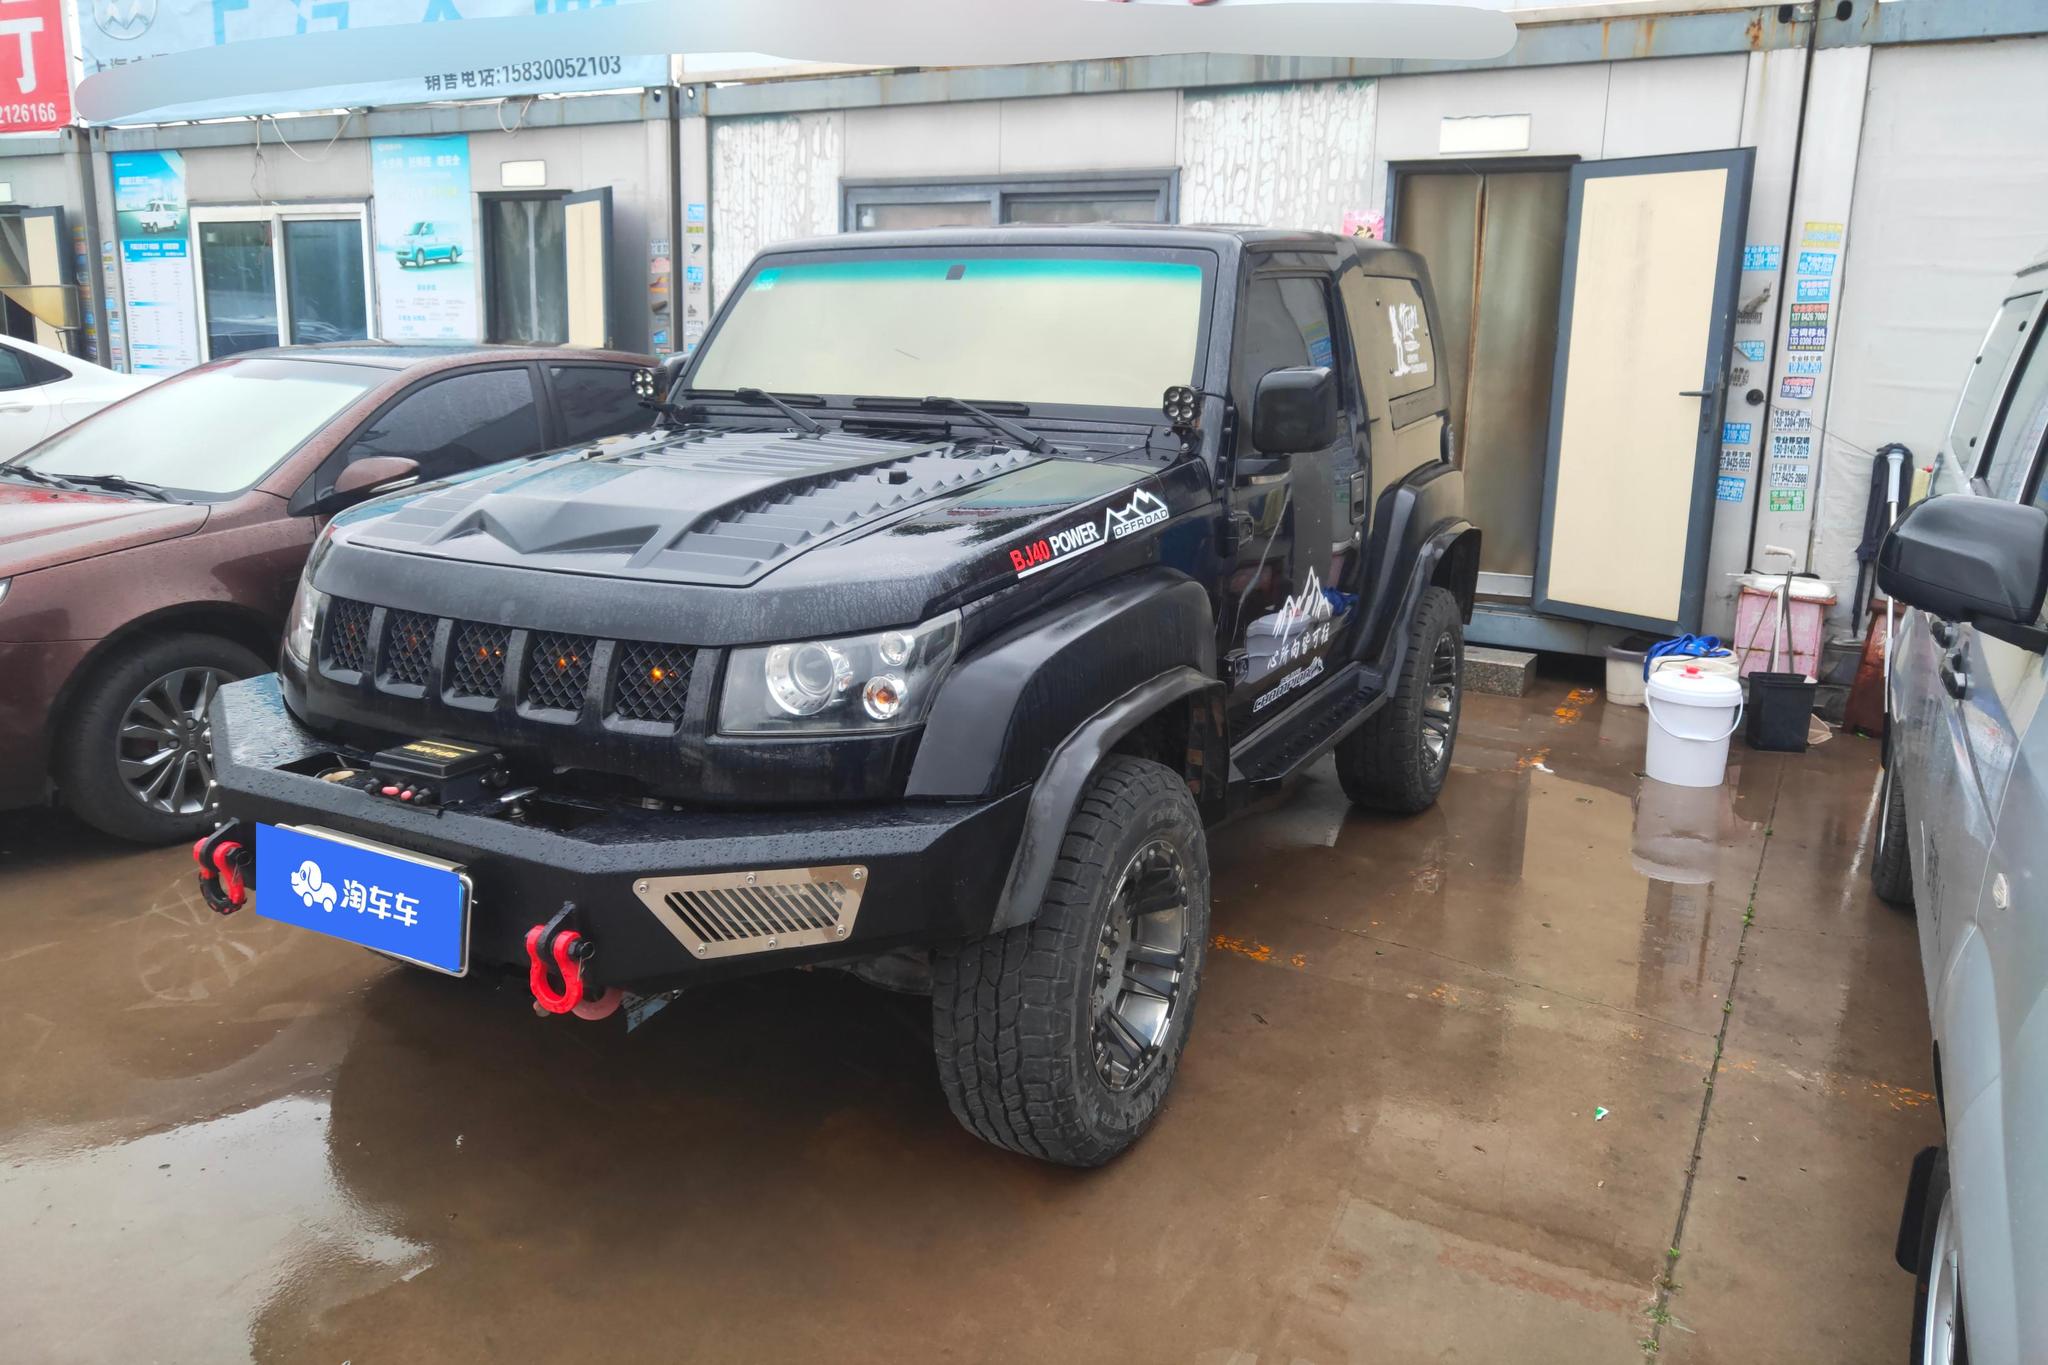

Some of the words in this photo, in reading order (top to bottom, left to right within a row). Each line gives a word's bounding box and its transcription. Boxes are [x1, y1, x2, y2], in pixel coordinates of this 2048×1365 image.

[1115, 508, 1168, 537] OFFROAD
[1010, 539, 1051, 572] BJ40
[1049, 521, 1100, 556] POWER
